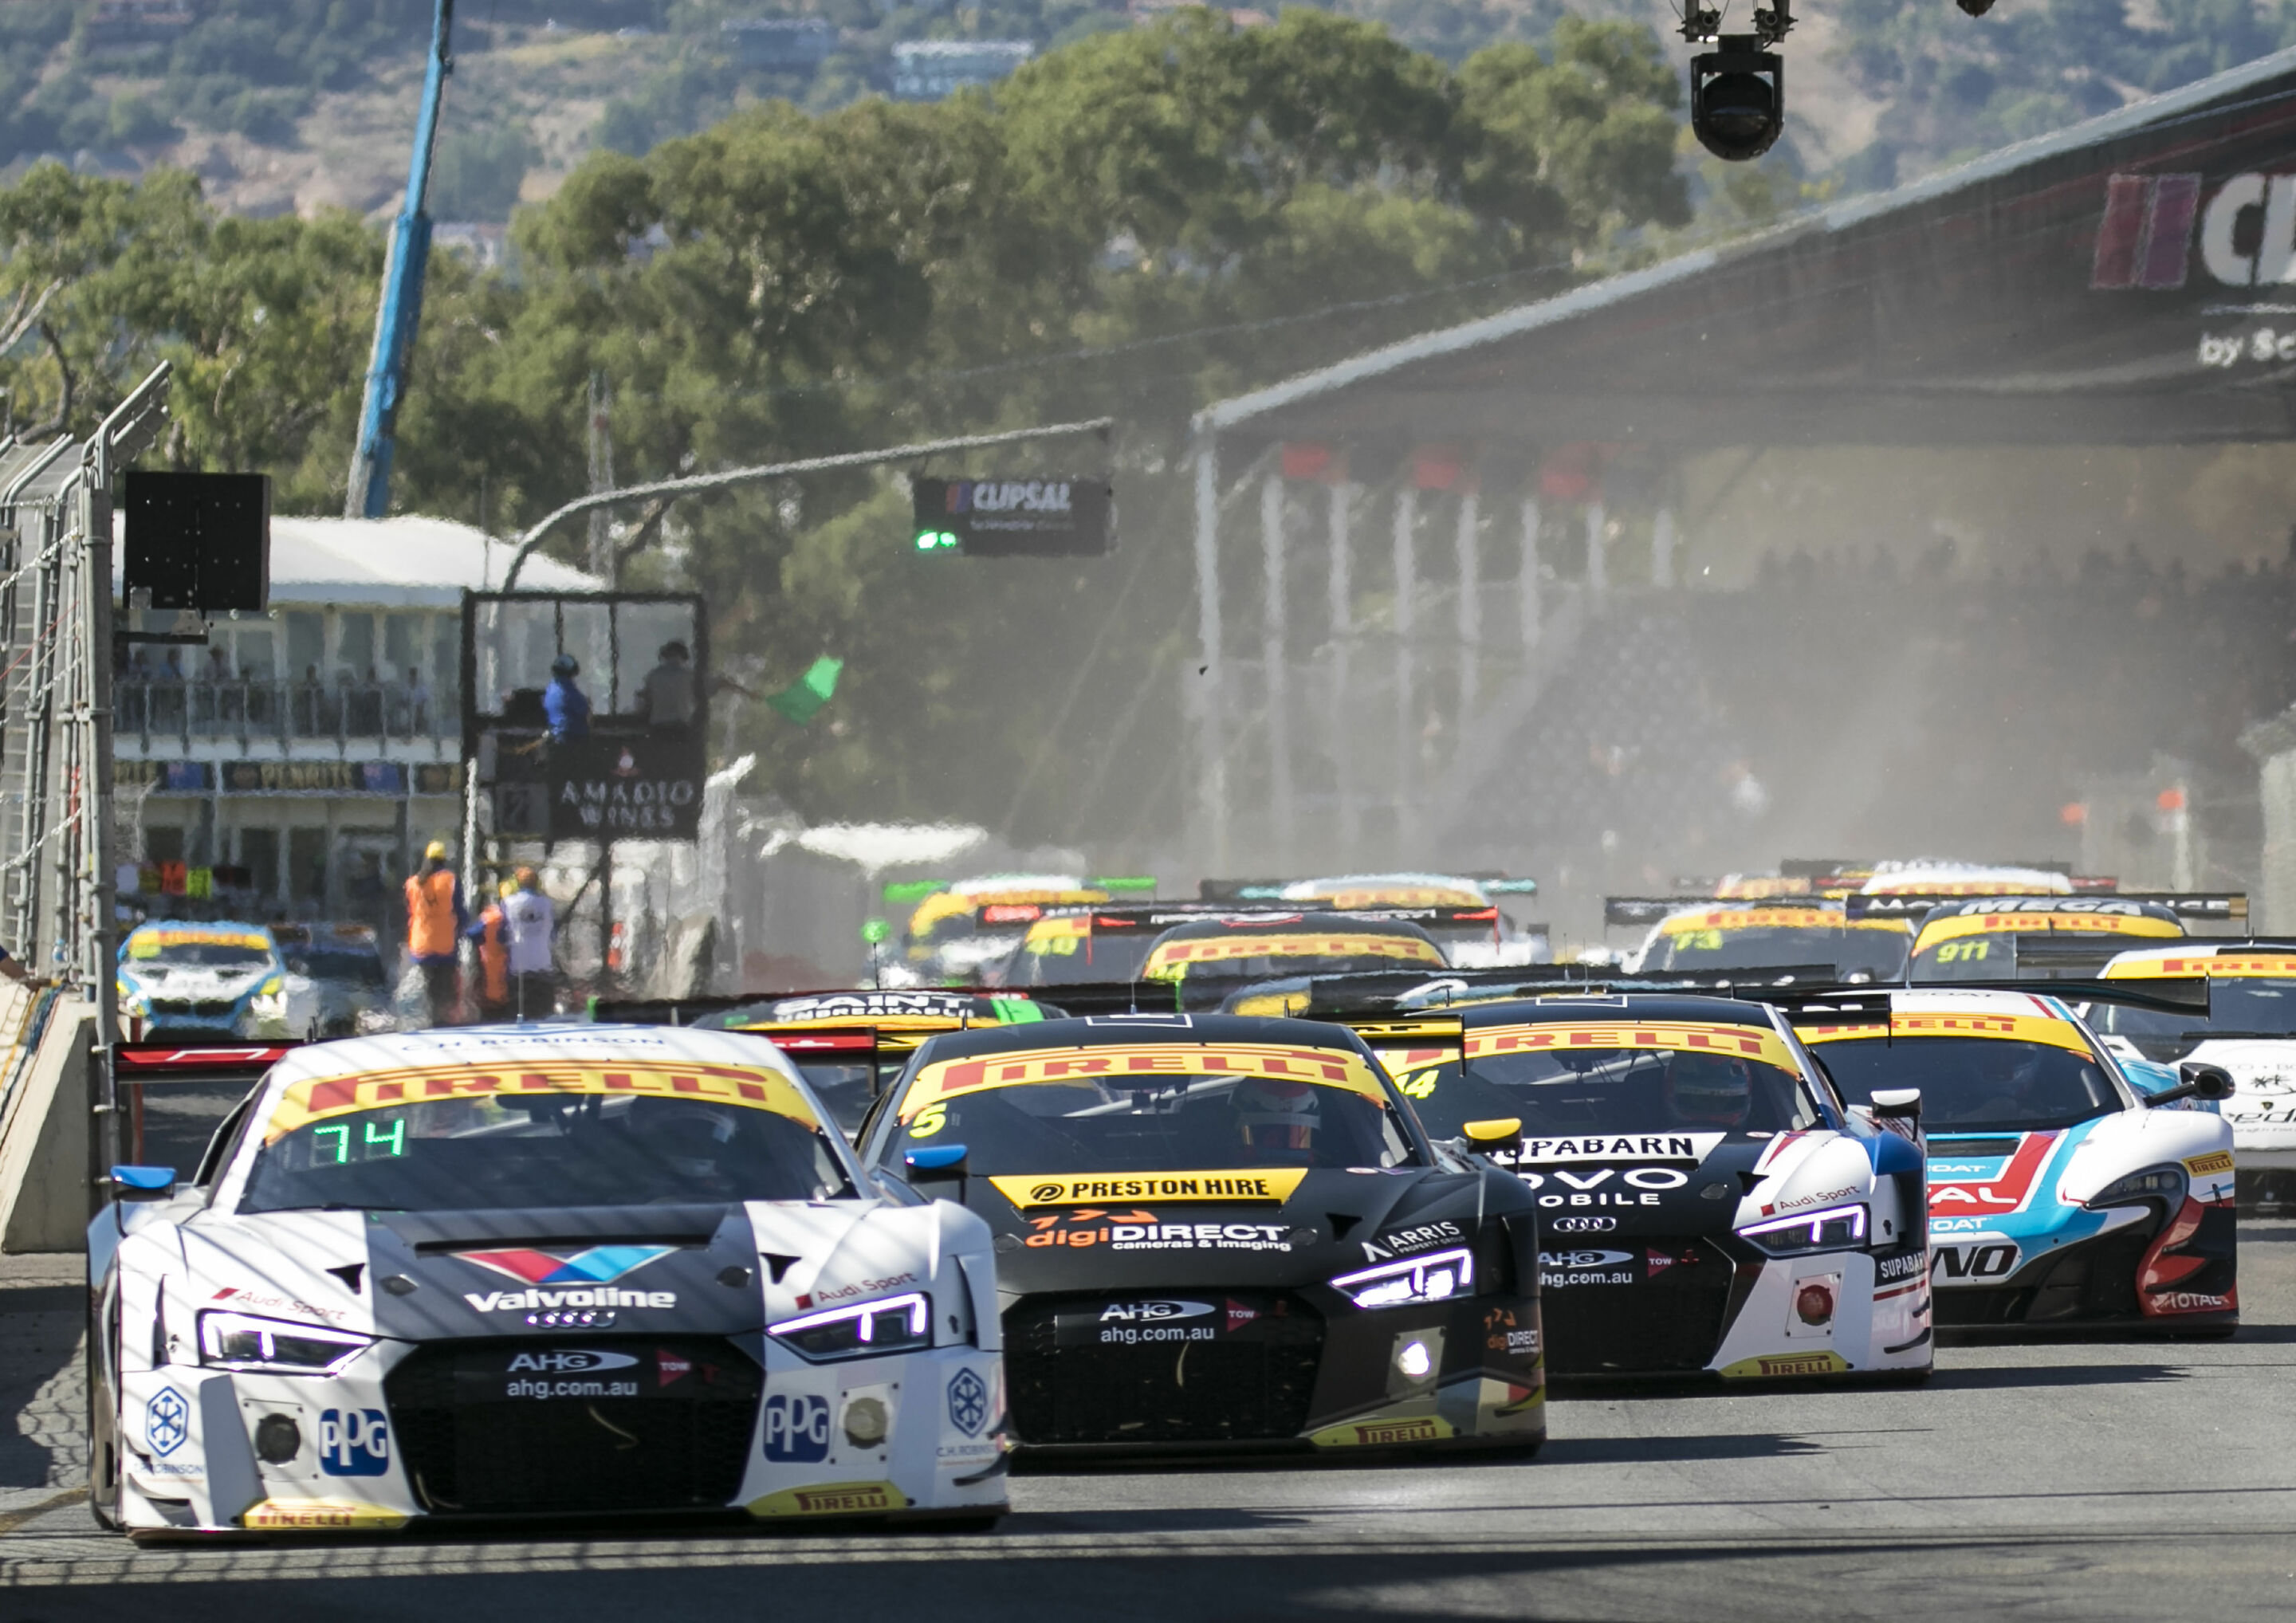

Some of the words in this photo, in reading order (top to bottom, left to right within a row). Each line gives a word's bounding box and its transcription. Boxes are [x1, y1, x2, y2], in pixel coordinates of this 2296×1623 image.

[2199, 331, 2243, 368] by
[561, 780, 694, 806] AMADIO
[579, 805, 675, 829] WINES
[1936, 941, 1990, 963] 911
[941, 1047, 1349, 1092] PIRELLI
[308, 1060, 769, 1113] PIRELLI
[910, 1103, 947, 1138] 5
[314, 1118, 404, 1164] 74
[2188, 1152, 2232, 1174] PIRELLI
[1071, 1180, 1197, 1198] PRESTON
[1204, 1178, 1269, 1196] HIRE
[1780, 1195, 1816, 1211] Audi
[1817, 1185, 1861, 1203] Sport
[1539, 1193, 1661, 1208] OBILE
[1025, 1224, 1285, 1248] digiDIRECT
[1112, 1240, 1193, 1250] cameras
[1198, 1239, 1212, 1248] &
[1217, 1239, 1292, 1252] imaging
[1388, 1221, 1461, 1248] ARRIS
[1538, 1252, 1595, 1266] AHG
[817, 1283, 862, 1303] Audi
[863, 1271, 918, 1298] Sport
[1539, 1271, 1633, 1288] hg.com.au
[238, 1291, 282, 1307] Audi
[287, 1299, 346, 1321] Sport
[464, 1287, 677, 1312] Valvoline
[2167, 1292, 2222, 1309] TOTAL
[1099, 1303, 1173, 1321] AHG
[1228, 1310, 1256, 1318] TOW
[1100, 1326, 1215, 1343] ahg.com.au
[506, 1353, 590, 1372] AHG
[659, 1362, 691, 1371] TOW
[1757, 1354, 1832, 1375] PIRELLI
[507, 1380, 637, 1399] ahg.com.au
[765, 1395, 828, 1452] PPG
[1354, 1420, 1437, 1444] PIRELLI
[322, 1408, 387, 1466] PPG
[794, 1486, 887, 1512] PIRELLI
[257, 1503, 355, 1527] PIRELLI
